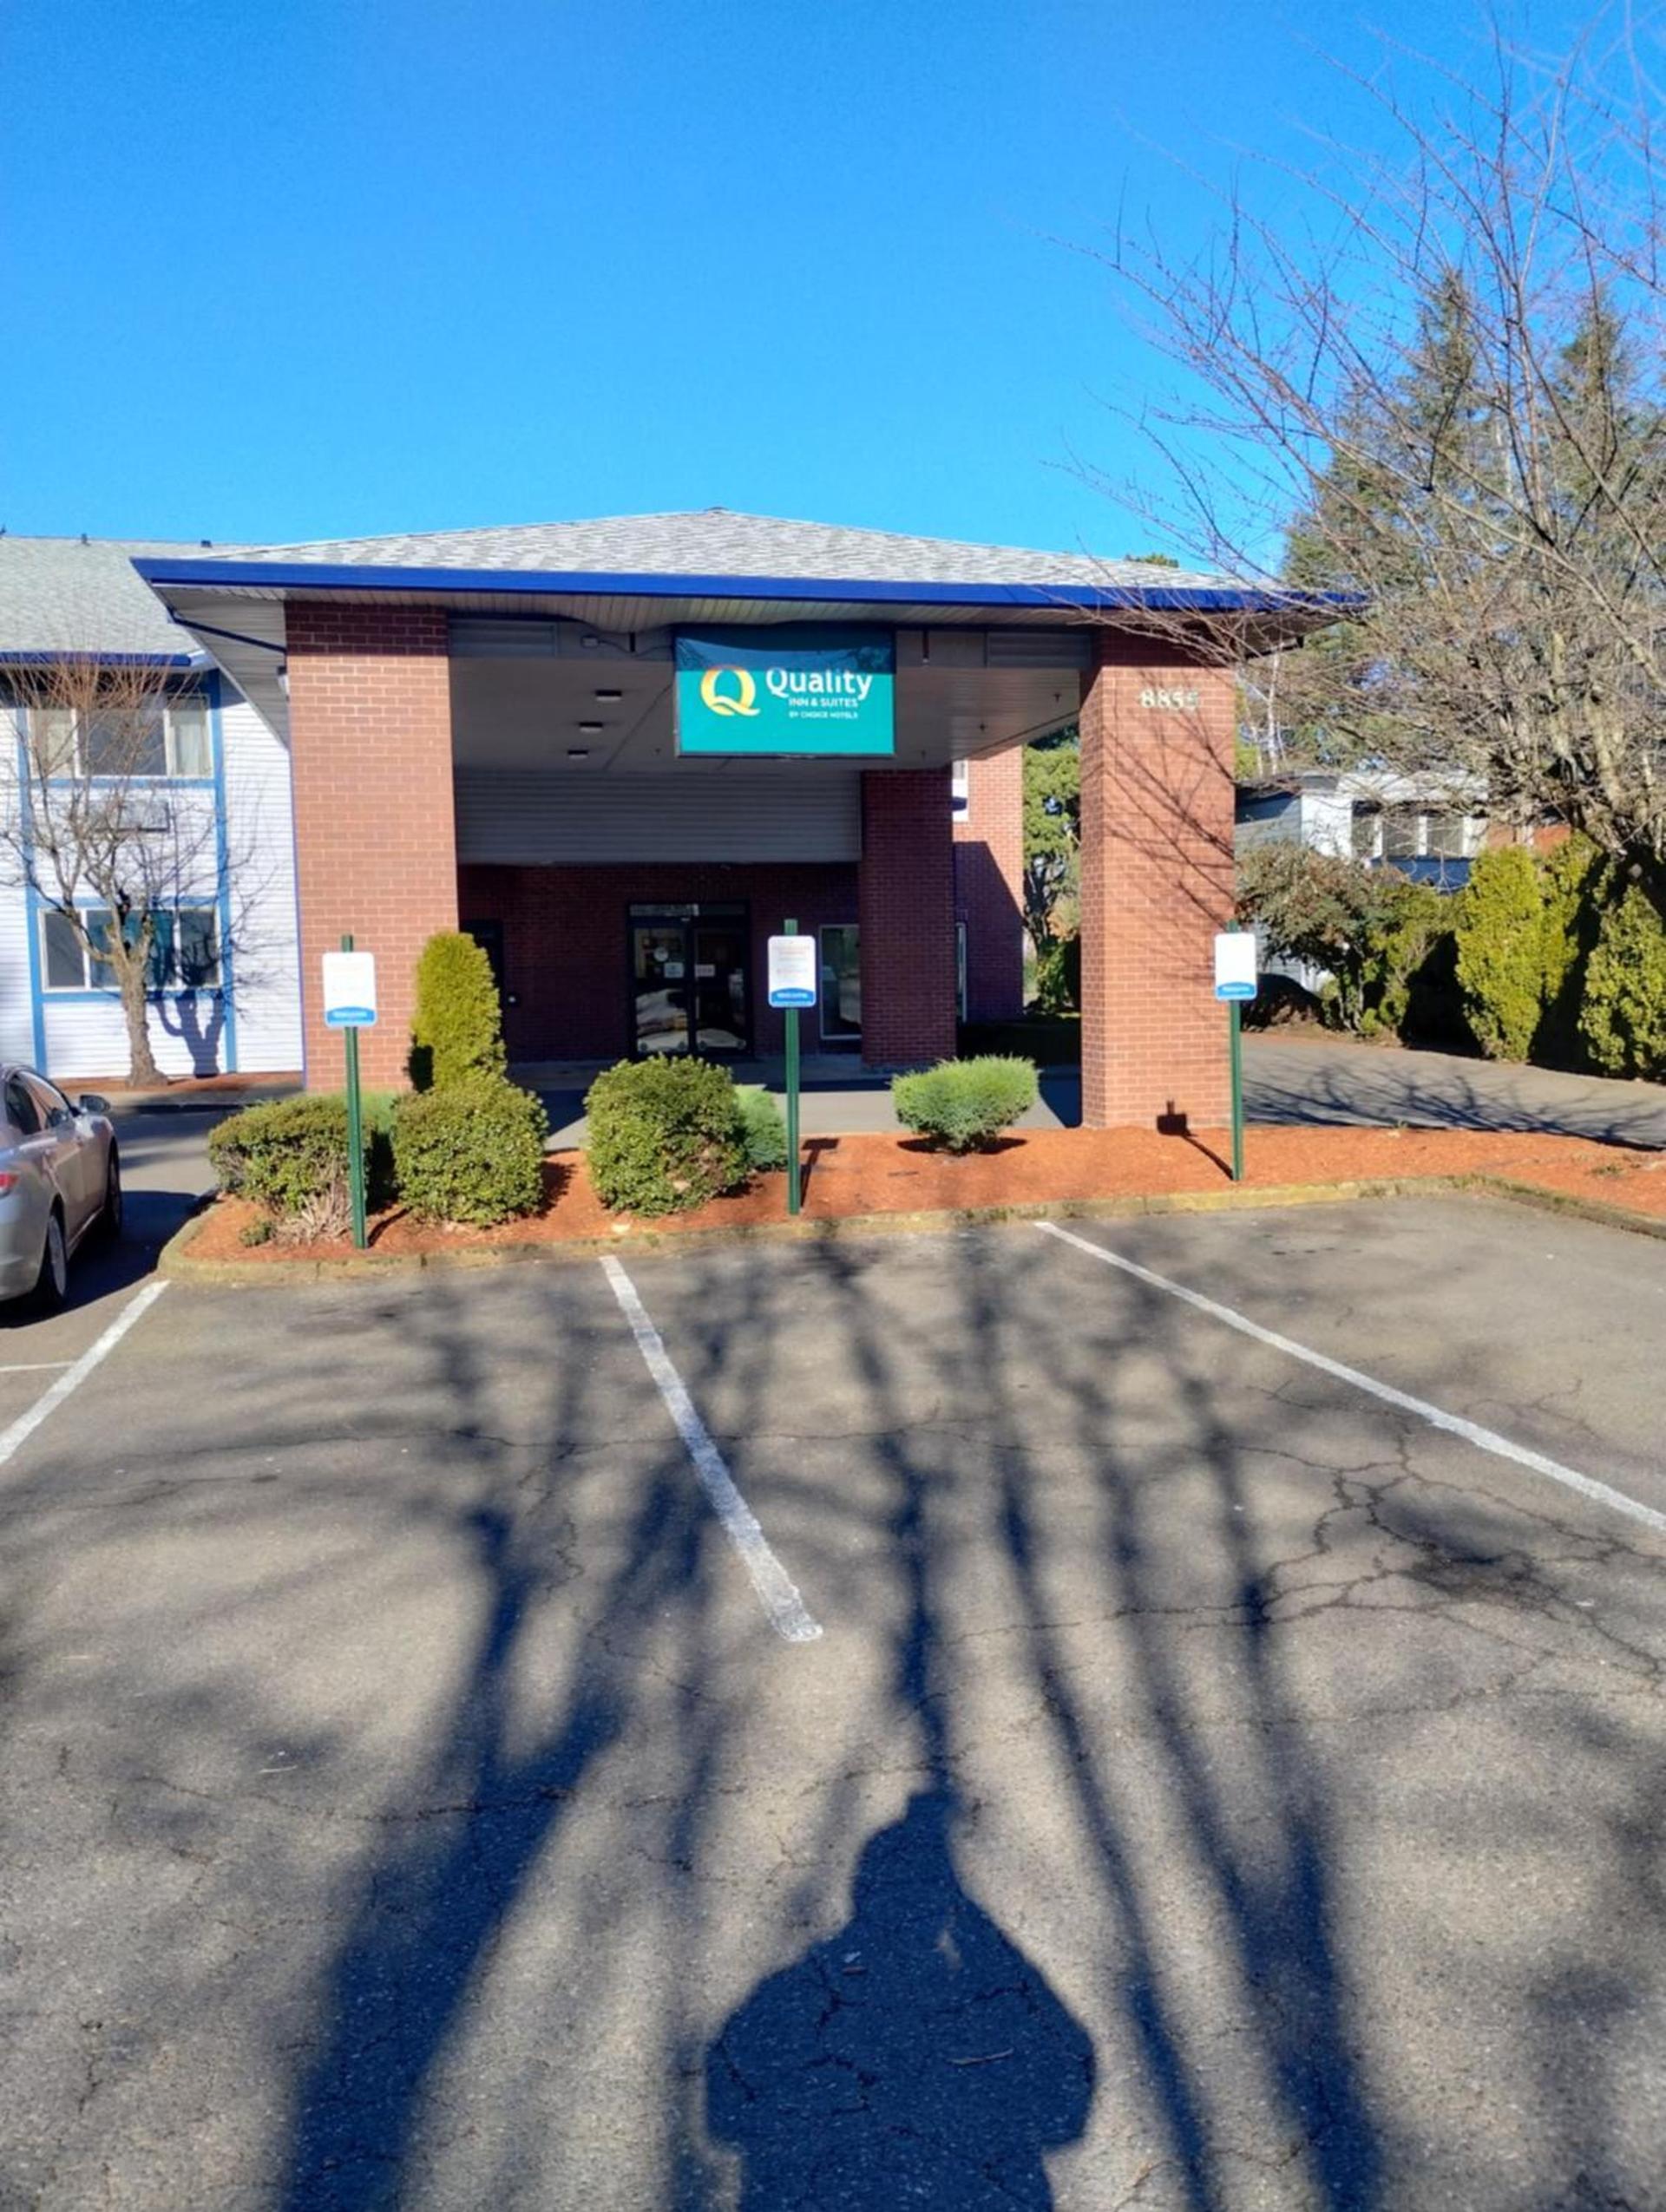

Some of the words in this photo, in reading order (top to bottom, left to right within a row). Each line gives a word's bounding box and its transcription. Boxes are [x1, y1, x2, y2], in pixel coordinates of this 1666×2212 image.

[700, 664, 760, 717] Q
[765, 666, 872, 700] Quality
[788, 697, 809, 707] INN
[810, 697, 818, 707] &
[820, 697, 858, 708] SUITES
